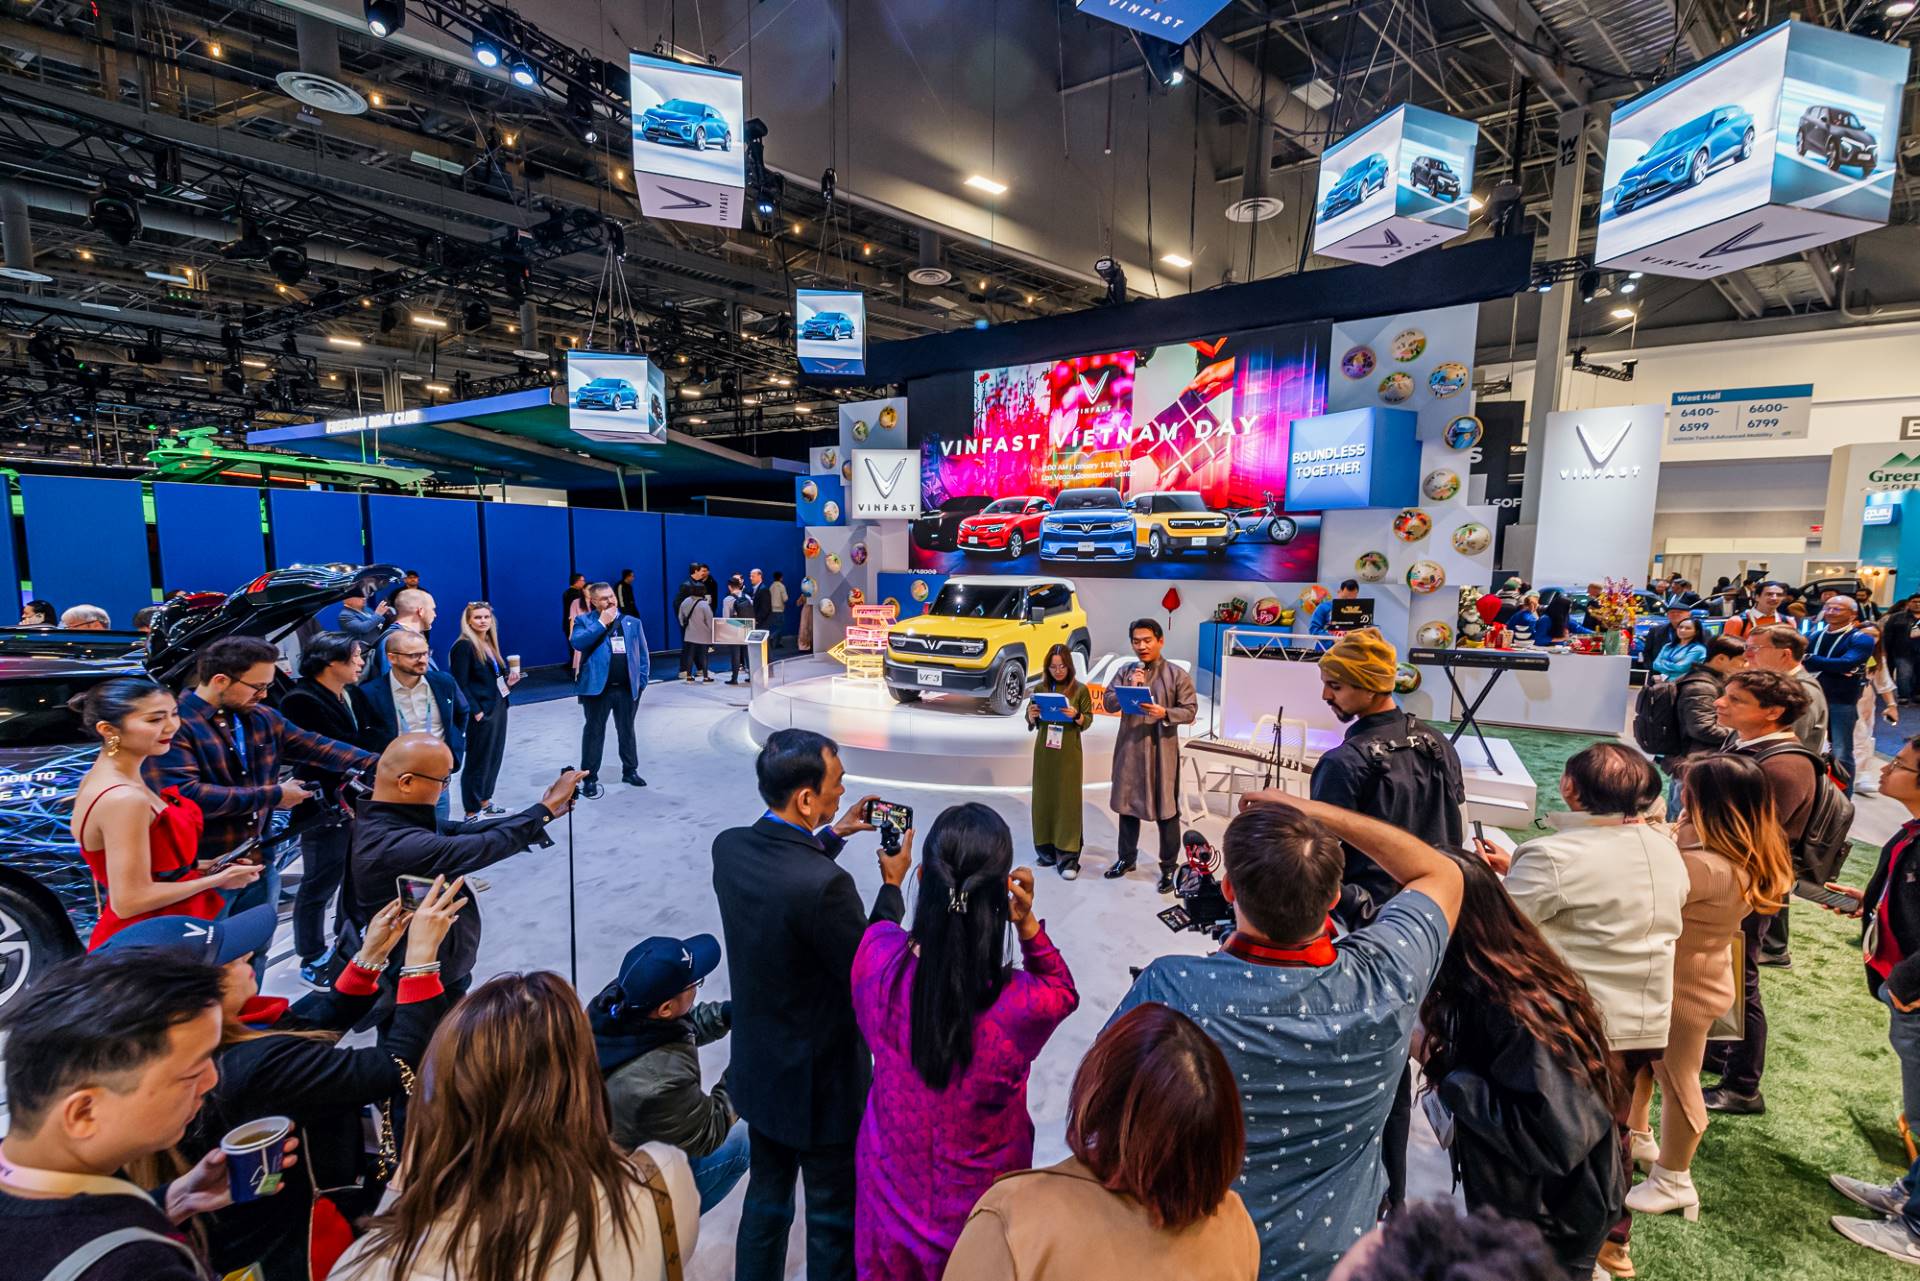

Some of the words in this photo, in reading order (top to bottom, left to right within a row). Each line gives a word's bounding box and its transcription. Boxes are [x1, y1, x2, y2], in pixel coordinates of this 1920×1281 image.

[1561, 135, 1578, 152] W
[1559, 152, 1576, 167] 12
[1640, 255, 1723, 272] VINFAST
[1677, 392, 1700, 402] West
[1702, 391, 1721, 401] Hall
[1681, 407, 1720, 418] 6400-
[1749, 403, 1789, 414] 6600-
[1679, 422, 1709, 432] 6599
[1747, 418, 1779, 428] 6799
[940, 433, 1040, 457] VINFAST
[1054, 422, 1178, 449] VIETNAM
[1195, 415, 1258, 439] DAY
[1292, 443, 1366, 464] BOUNDLESS
[1295, 460, 1361, 479] TOGETHER
[1559, 465, 1641, 480] VINFAST
[858, 503, 916, 512] VINFAST
